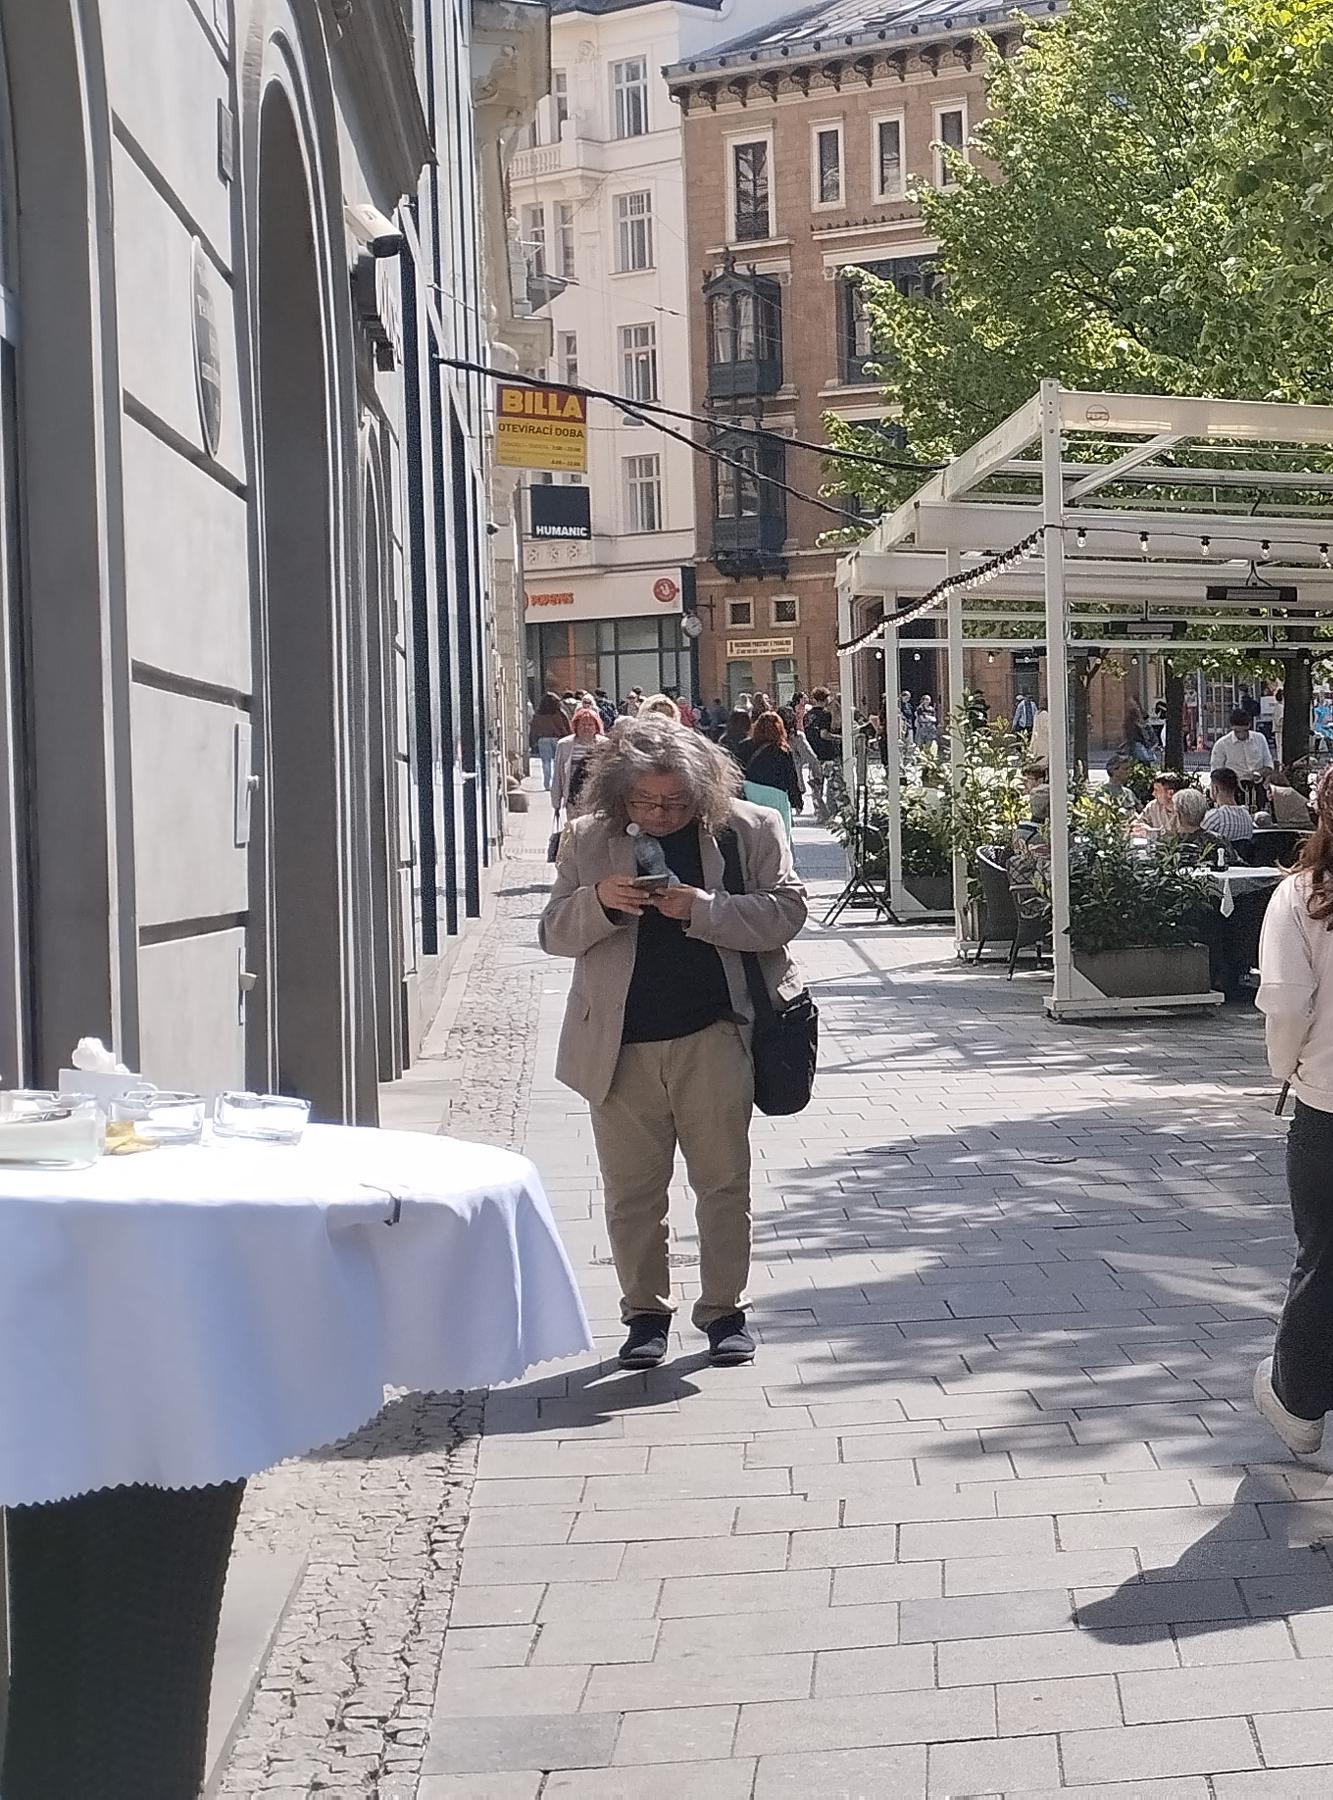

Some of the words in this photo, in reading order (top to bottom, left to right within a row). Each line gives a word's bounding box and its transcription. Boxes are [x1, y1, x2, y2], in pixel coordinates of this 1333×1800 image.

[502, 388, 583, 419] BILLA
[498, 422, 553, 436] OTEVÍRACÍ
[555, 427, 585, 438] DOBA
[536, 525, 588, 537] HUMANIC
